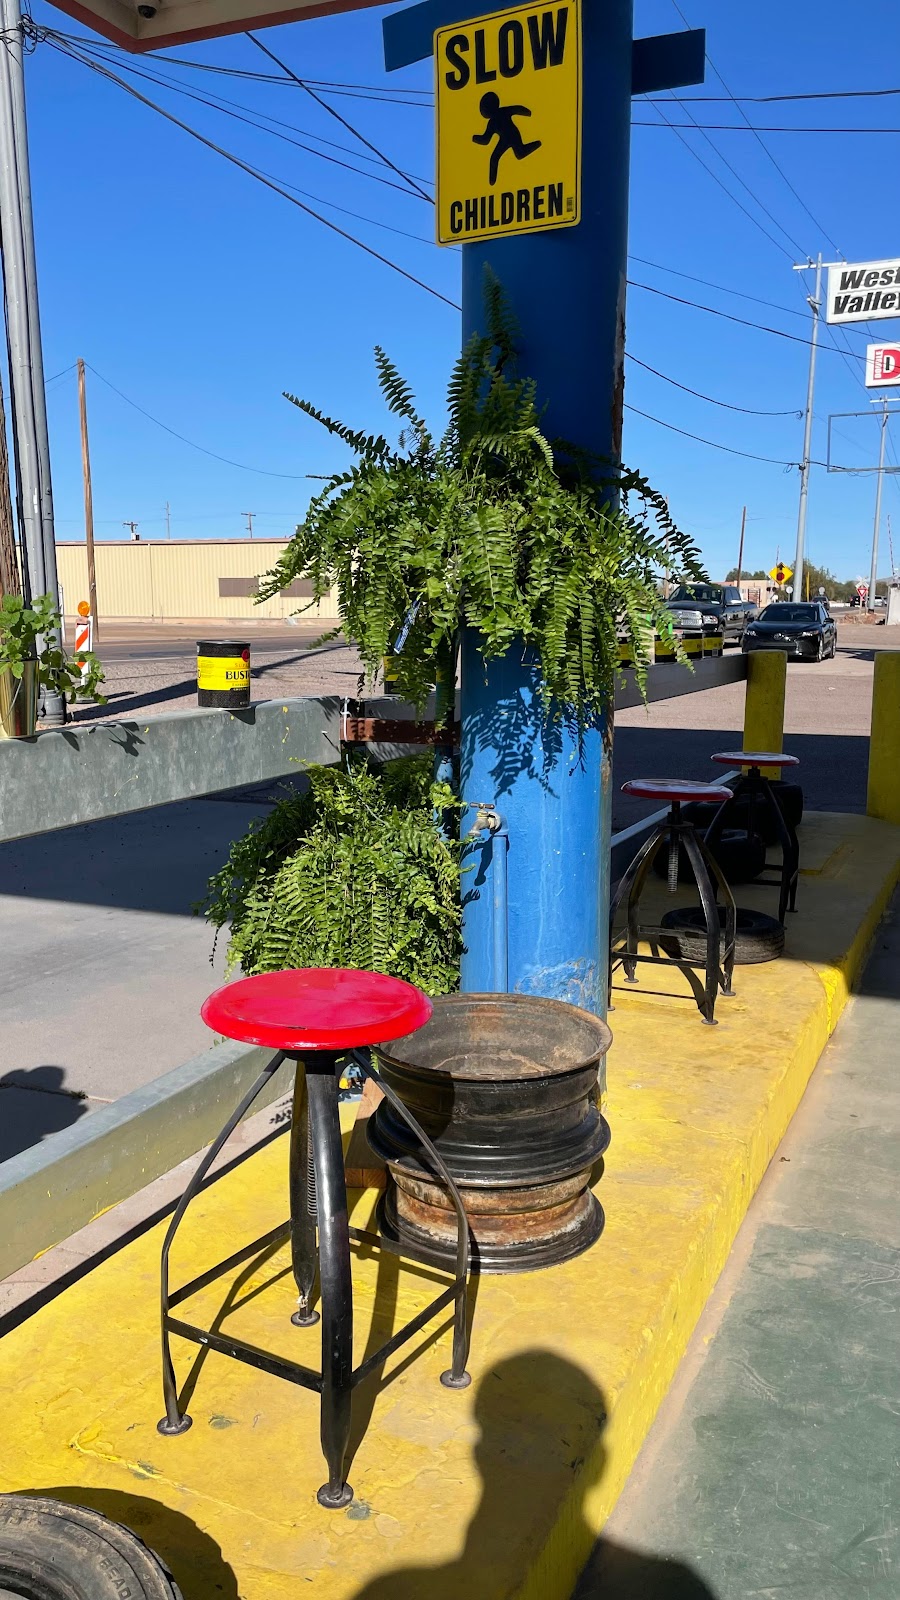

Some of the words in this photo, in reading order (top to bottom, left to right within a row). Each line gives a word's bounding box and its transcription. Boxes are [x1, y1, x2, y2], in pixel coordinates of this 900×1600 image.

[445, 7, 568, 91] SLOW
[450, 182, 563, 234] CHILDREN
[839, 267, 900, 291] West
[225, 670, 249, 680] BUST
